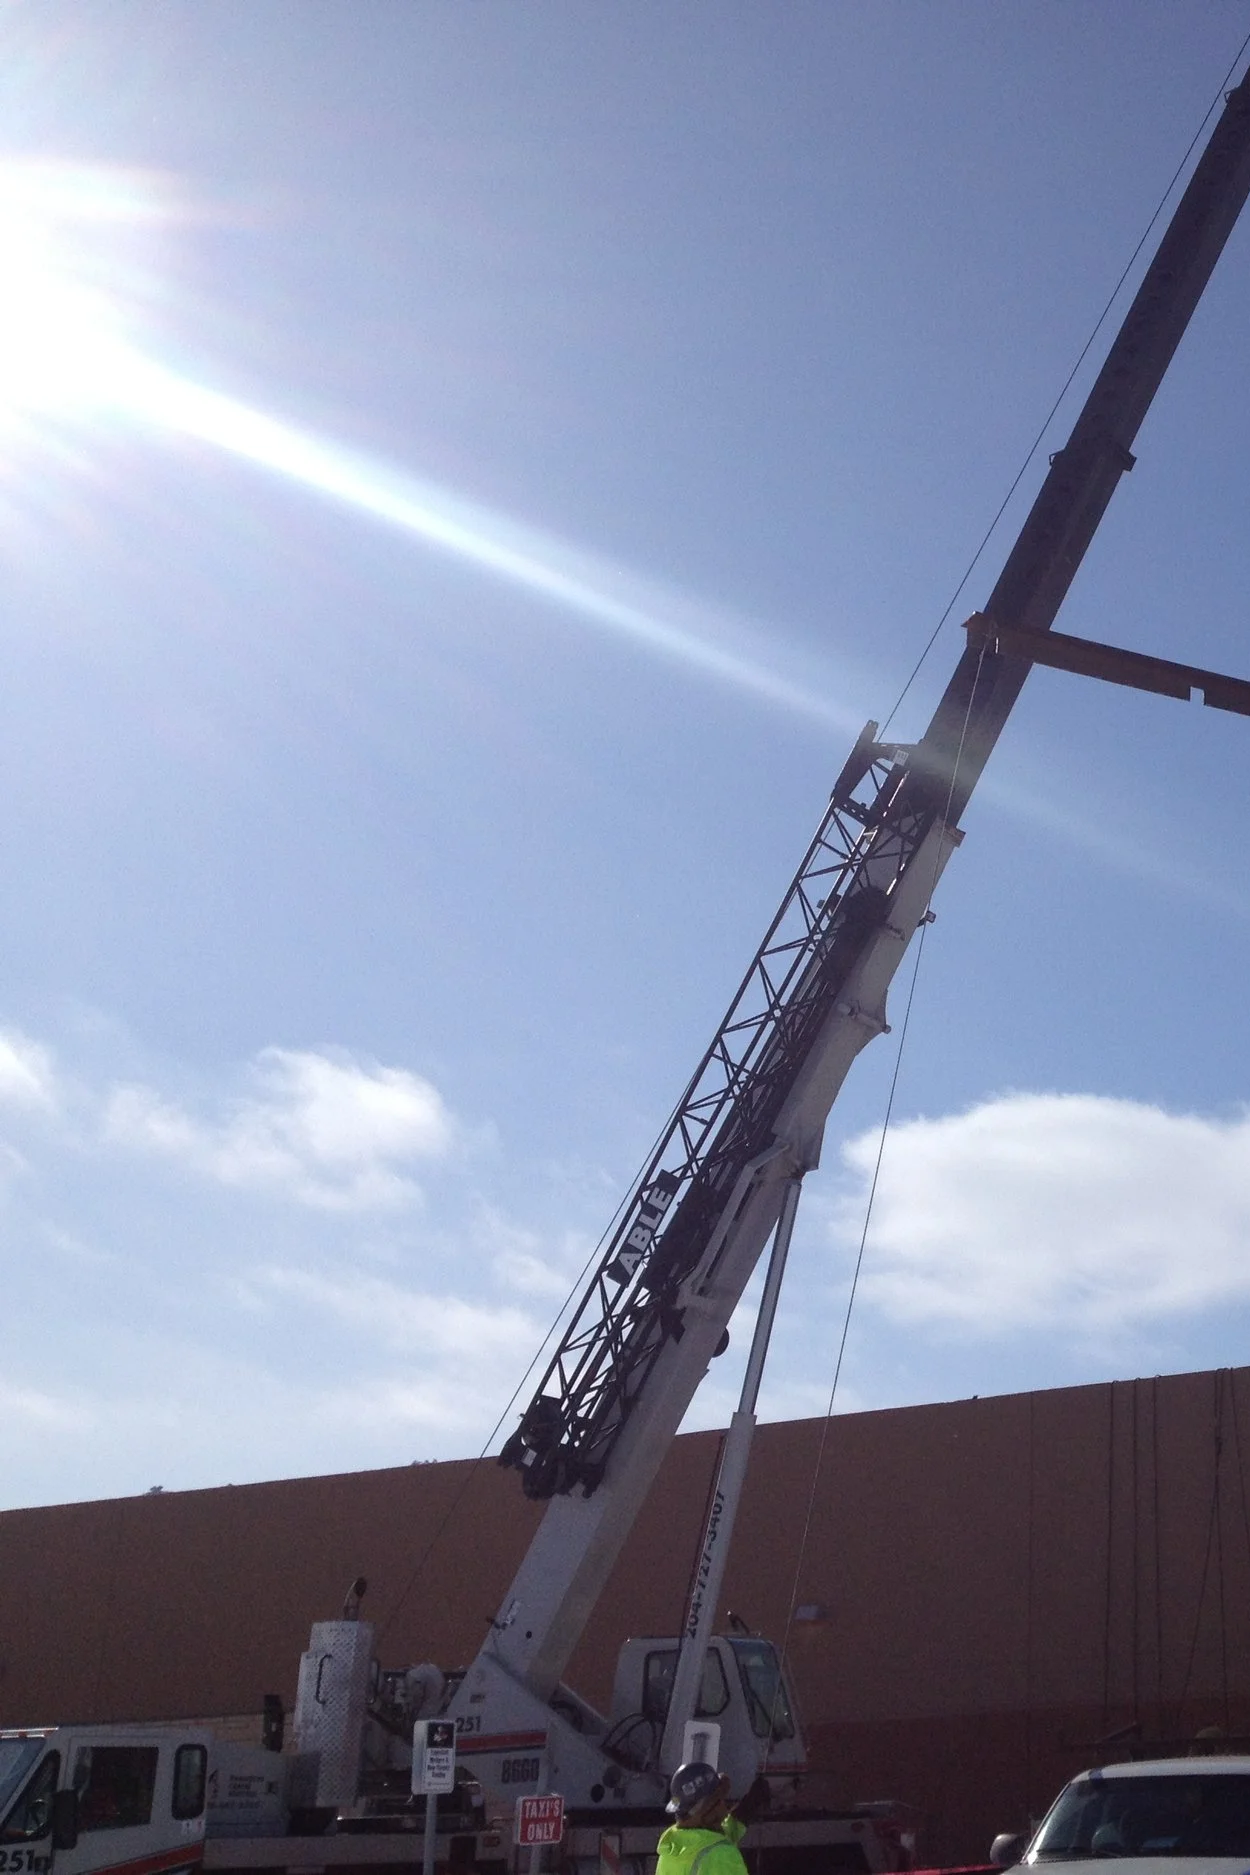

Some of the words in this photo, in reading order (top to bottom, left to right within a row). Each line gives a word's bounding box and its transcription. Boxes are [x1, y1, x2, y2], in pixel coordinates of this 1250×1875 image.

[619, 1187, 672, 1276] ABLE
[686, 1490, 725, 1639] 204-727-3407
[455, 1716, 481, 1733] 251
[525, 1800, 560, 1819] TAXI'S
[527, 1822, 555, 1840] ONLY
